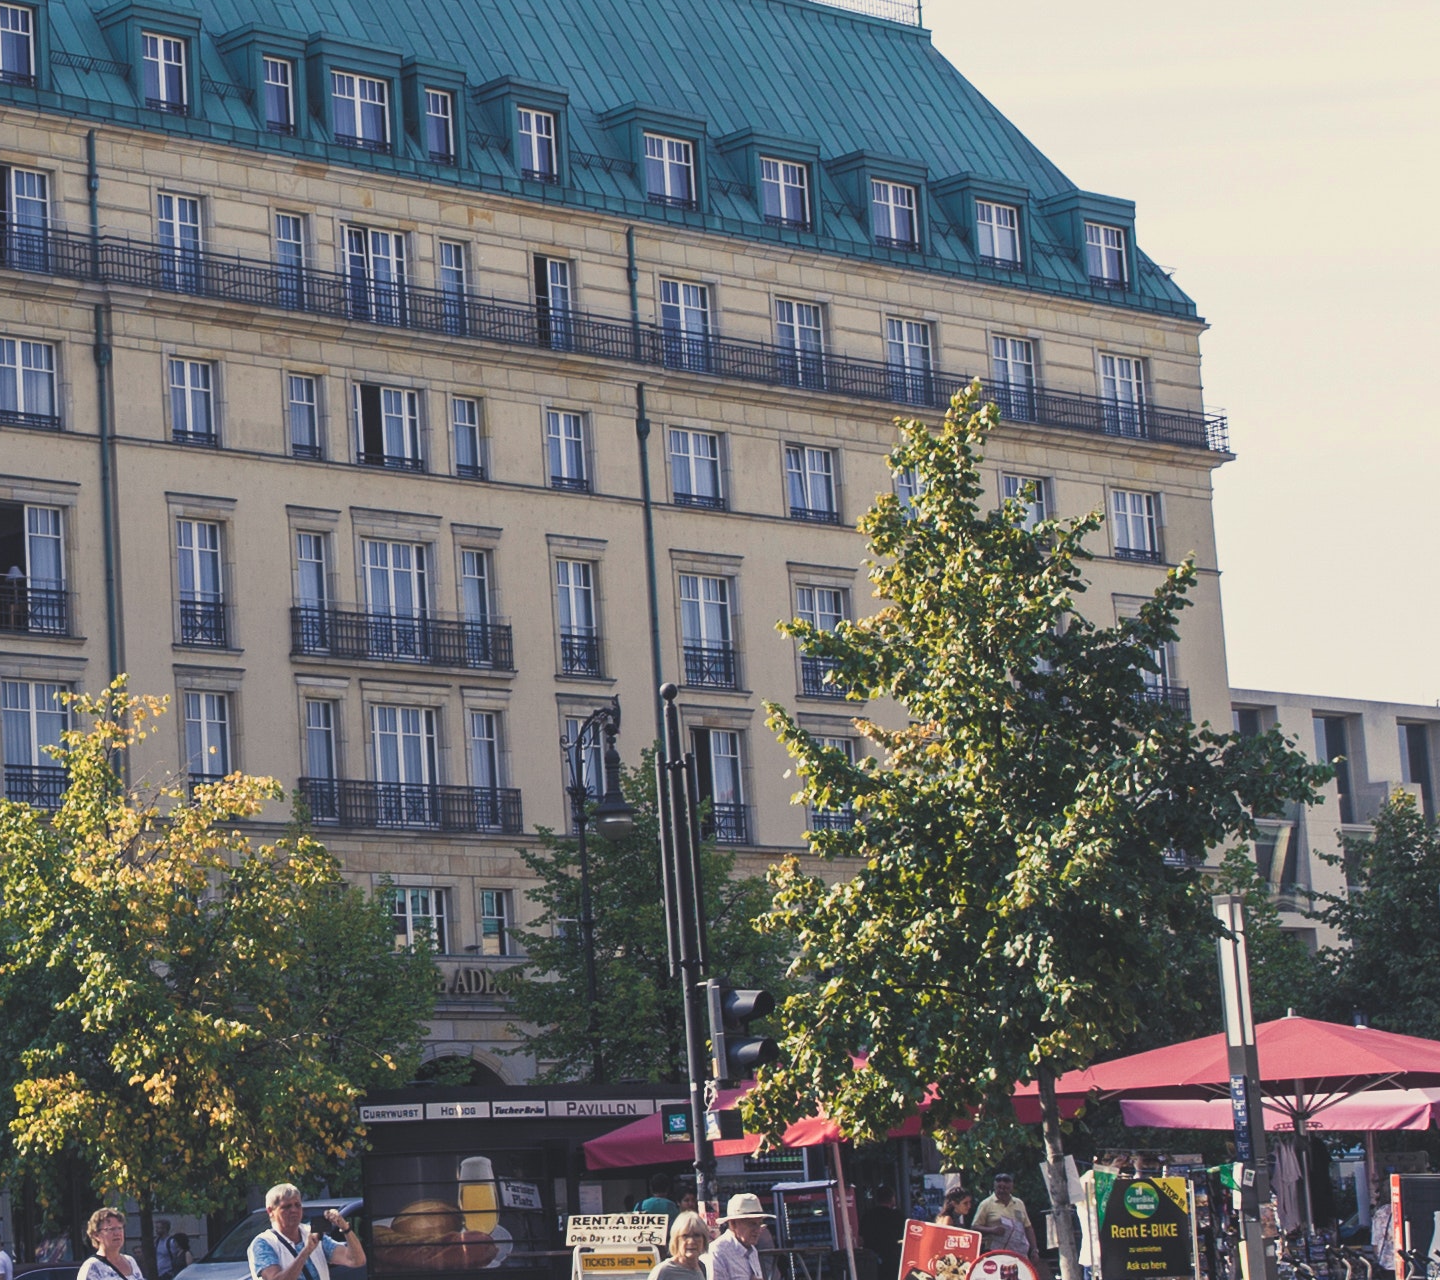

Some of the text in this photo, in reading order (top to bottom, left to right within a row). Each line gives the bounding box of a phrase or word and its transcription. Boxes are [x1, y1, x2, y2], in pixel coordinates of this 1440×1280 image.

[363, 1108, 419, 1120] CURRYWURST
[566, 1101, 637, 1116] PAVILLON
[1162, 1182, 1179, 1202] STOP
[572, 1216, 666, 1226] RENT A BIKE
[1111, 1223, 1178, 1238] Rent E-BIKE
[570, 1234, 586, 1243] One
[589, 1234, 605, 1244] Day
[585, 1257, 636, 1267] TICKETS HIER
[1127, 1261, 1140, 1270] Ask
[1151, 1261, 1167, 1270] here
